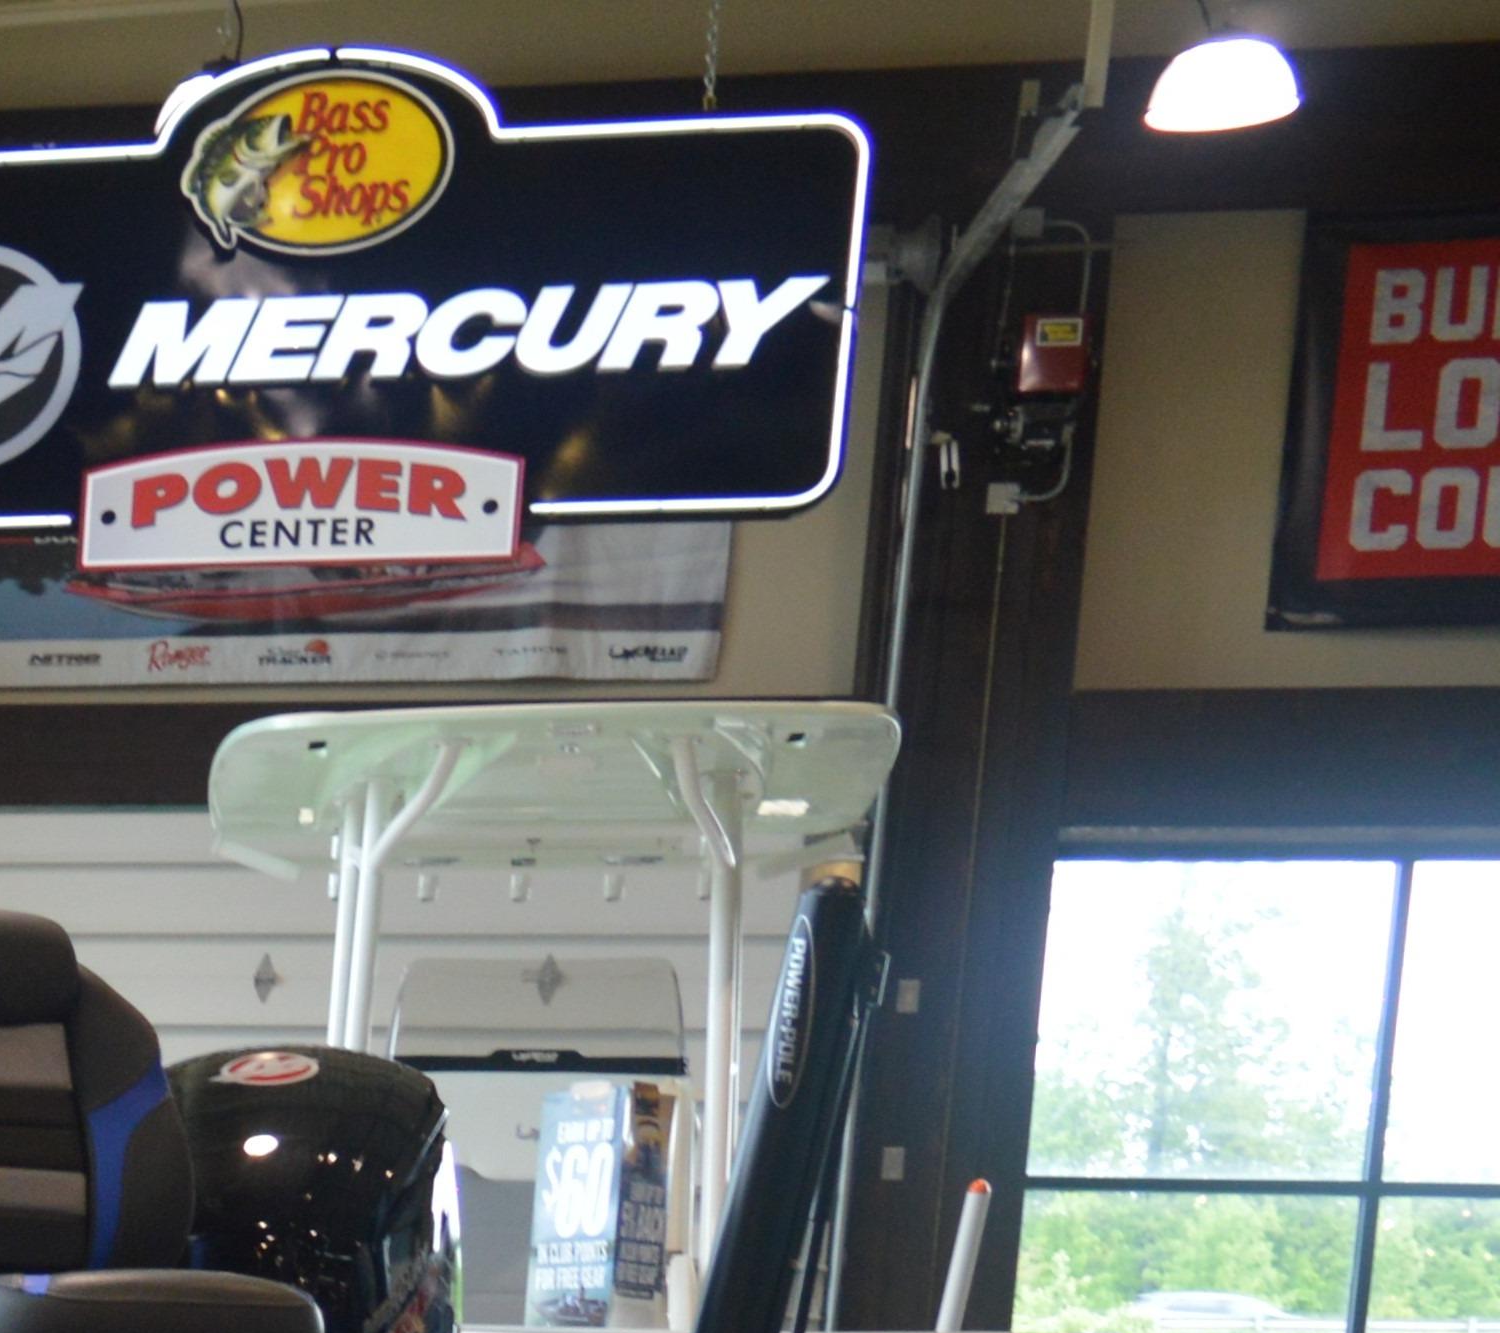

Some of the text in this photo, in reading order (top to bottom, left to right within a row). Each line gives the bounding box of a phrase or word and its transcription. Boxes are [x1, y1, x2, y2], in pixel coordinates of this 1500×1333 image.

[294, 91, 391, 134] Bass
[295, 134, 366, 176] Pro
[292, 175, 410, 226] Shops
[108, 275, 830, 390] MERCURY
[131, 457, 467, 530] POWER
[1349, 466, 1500, 552] CO
[220, 518, 375, 549] CENTER
[774, 937, 807, 1085] POWER-POLE
[542, 1141, 615, 1238] $60
